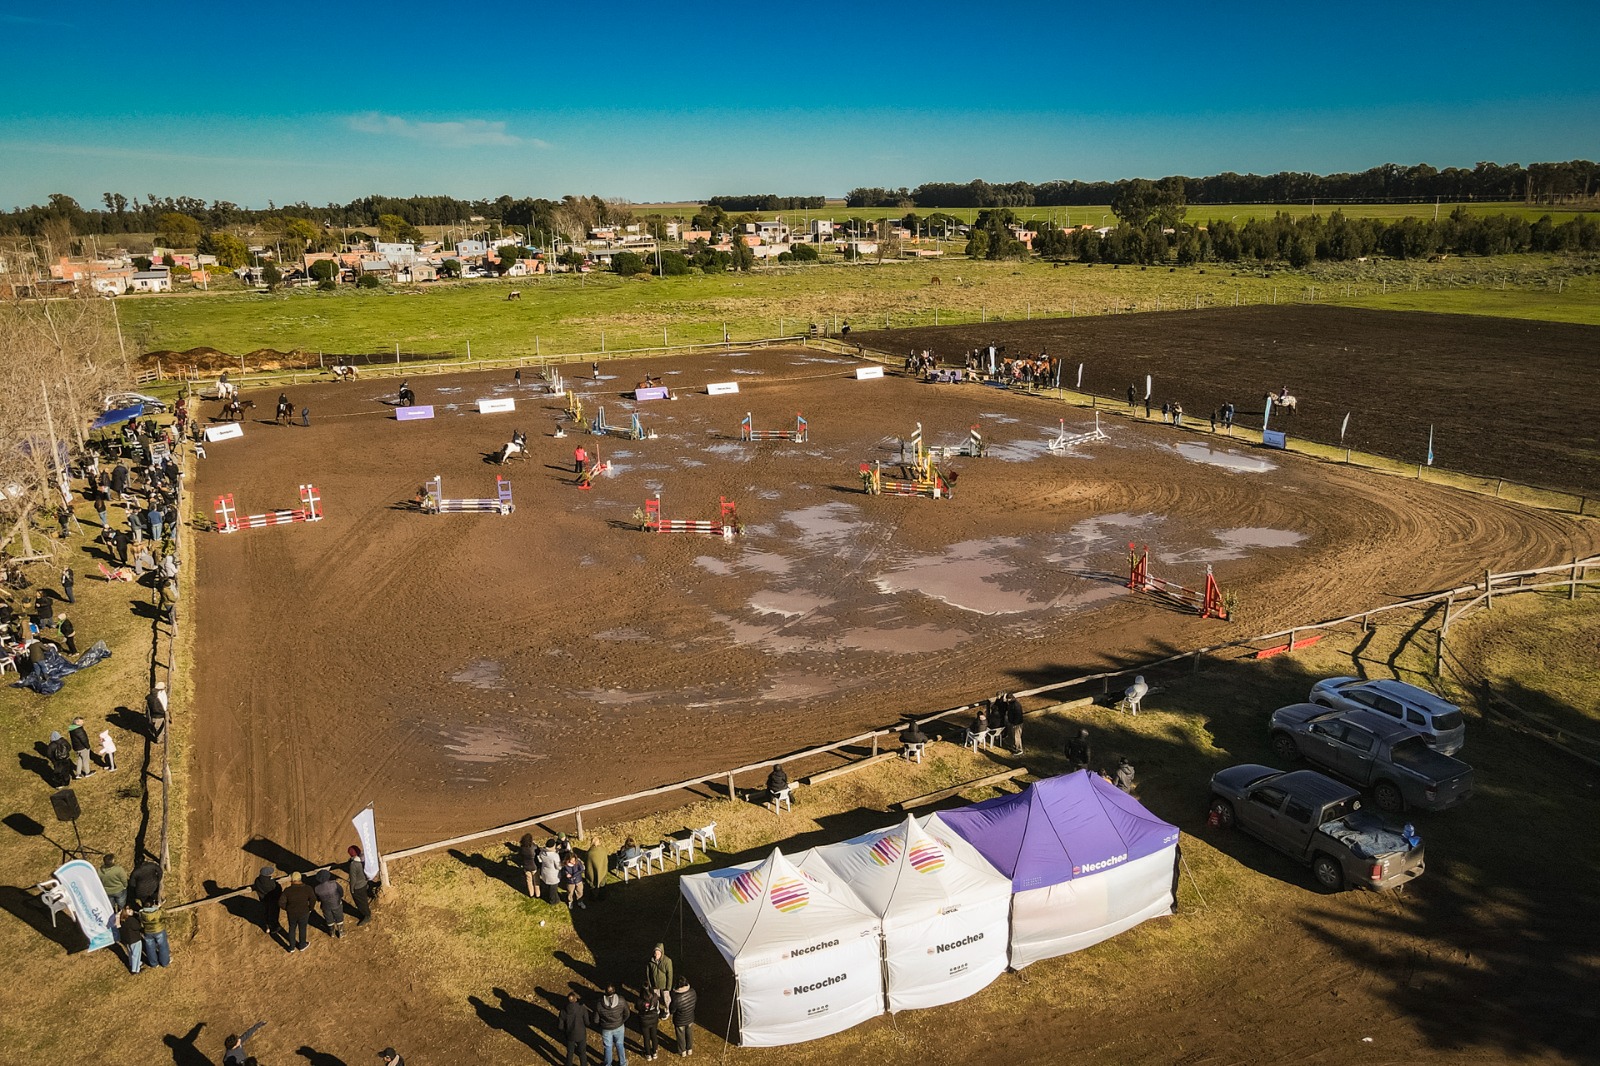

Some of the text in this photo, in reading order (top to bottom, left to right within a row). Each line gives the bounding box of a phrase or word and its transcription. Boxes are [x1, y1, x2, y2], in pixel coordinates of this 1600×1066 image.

[1081, 853, 1128, 874] Necochea
[790, 938, 840, 958] Necochea
[935, 932, 984, 954] Necochea
[793, 972, 848, 995] Necochea
